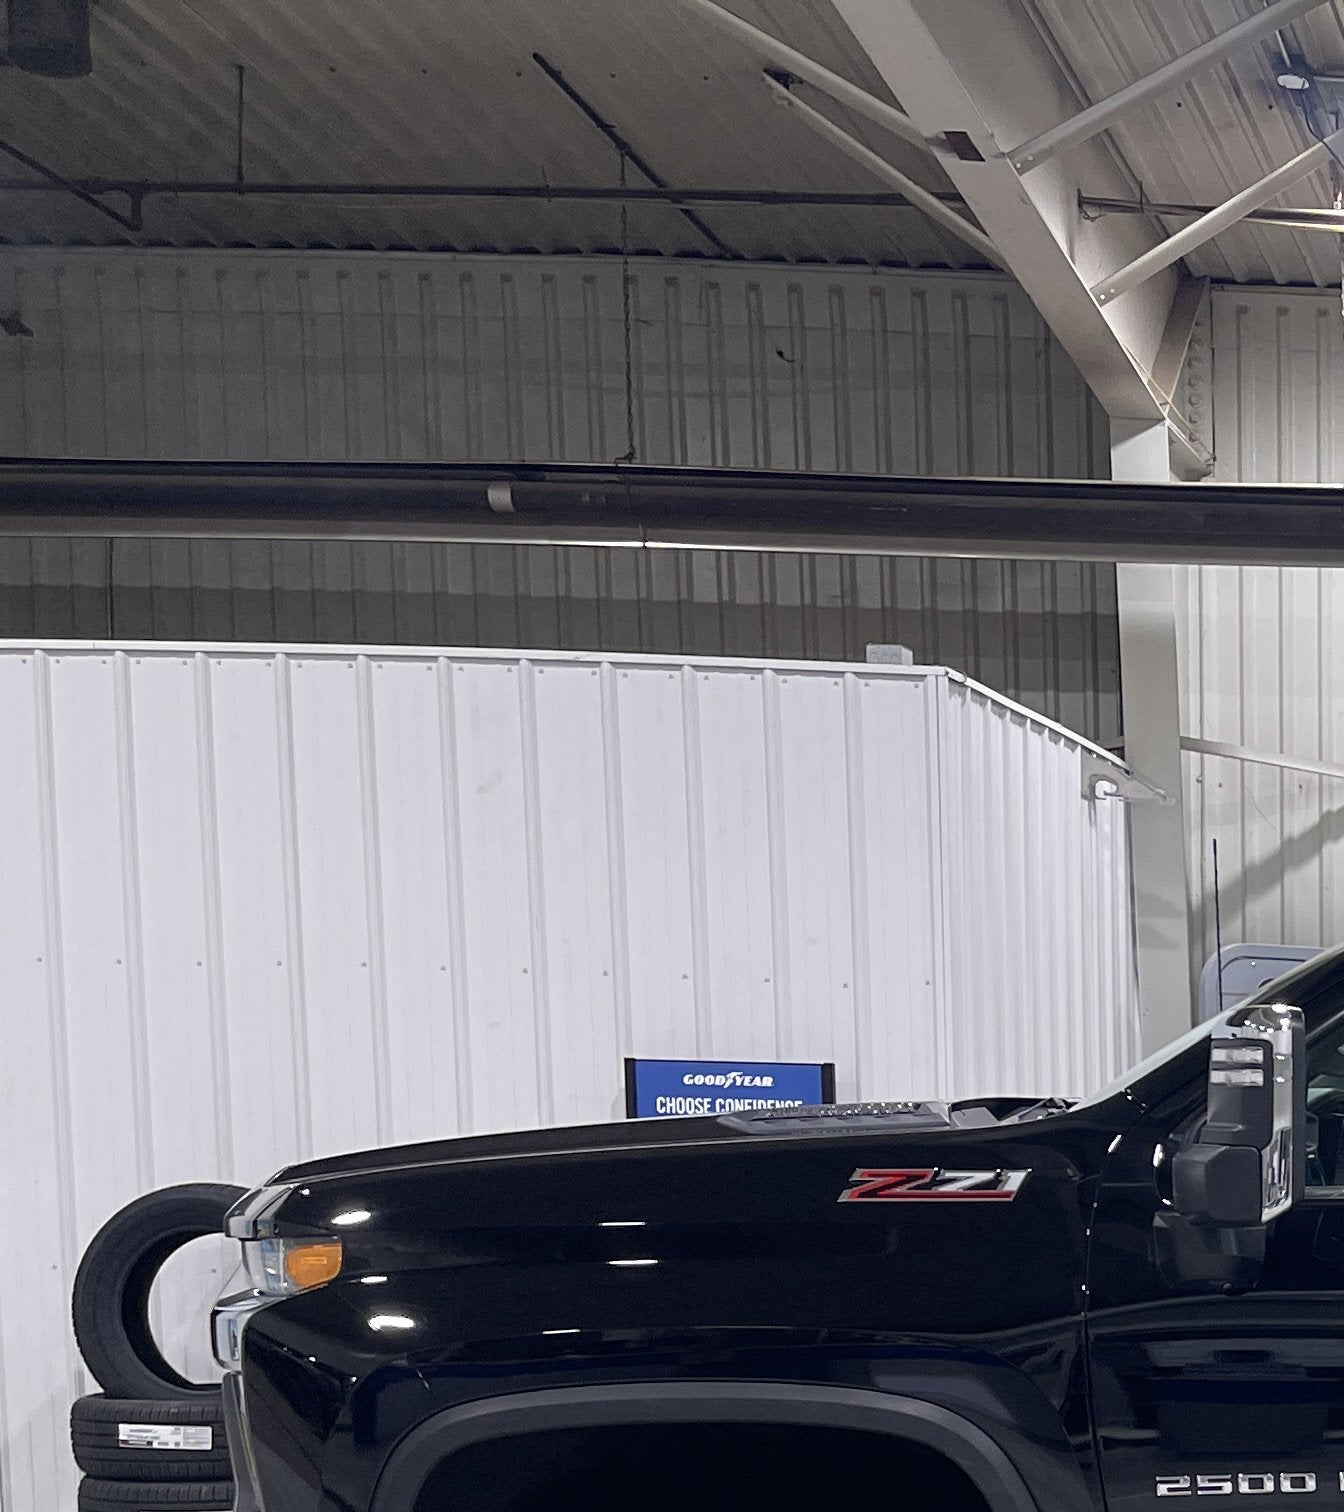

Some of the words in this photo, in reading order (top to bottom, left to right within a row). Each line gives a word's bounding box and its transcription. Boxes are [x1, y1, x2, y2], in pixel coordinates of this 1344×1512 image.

[683, 1071, 774, 1088] GOODYEAR
[656, 1096, 712, 1114] CHOOSE
[838, 1168, 1033, 1202] Z71
[1155, 1471, 1317, 1497] 2500
